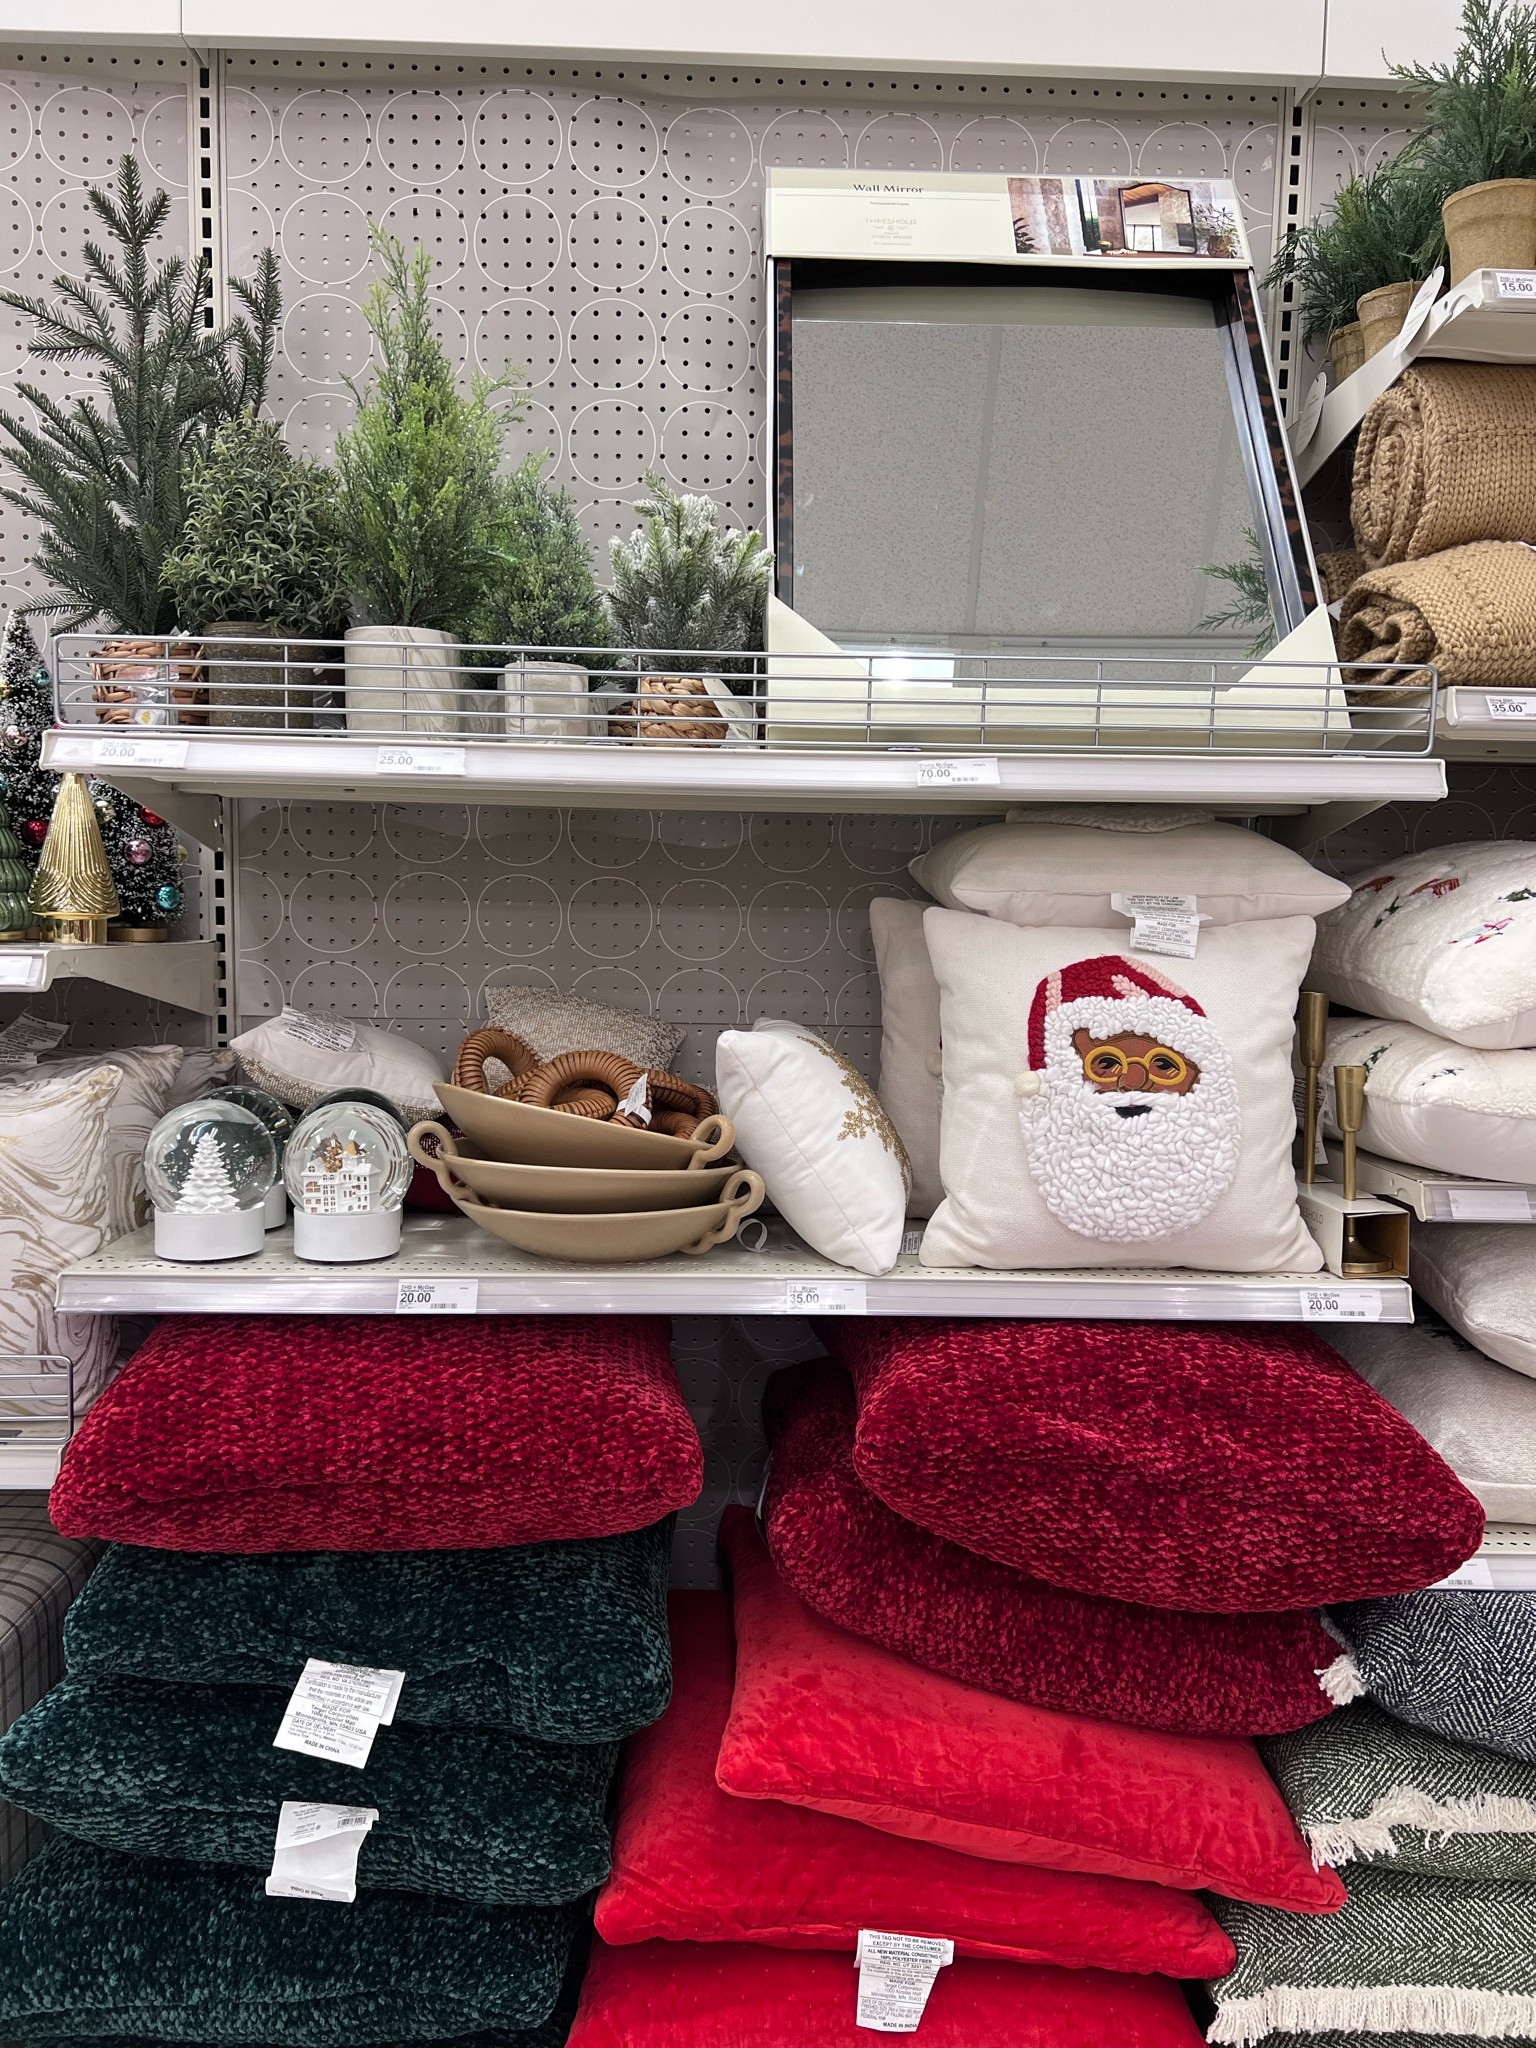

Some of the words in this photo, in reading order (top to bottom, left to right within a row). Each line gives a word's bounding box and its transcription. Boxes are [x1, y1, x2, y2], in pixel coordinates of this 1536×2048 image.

[853, 184, 879, 192] Wall
[883, 185, 924, 193] Mirror
[1502, 283, 1533, 292] 15.00
[1492, 705, 1523, 713] 35.00
[100, 747, 135, 757] 20.00
[379, 756, 413, 765] 25.00
[920, 769, 951, 778] 70.00
[400, 1293, 431, 1303] 20.00
[790, 1294, 819, 1303] 35.00
[1309, 1300, 1339, 1310] 20.00
[322, 1703, 339, 1711] MADE
[311, 1704, 327, 1713] Target
[328, 1709, 359, 1721] Corporation
[313, 1723, 337, 1732] DELIVERY
[339, 1722, 354, 1731] 55403
[304, 1740, 318, 1748] MADE
[325, 1746, 340, 1754] CHINA
[913, 1944, 941, 1952] CONSUMER
